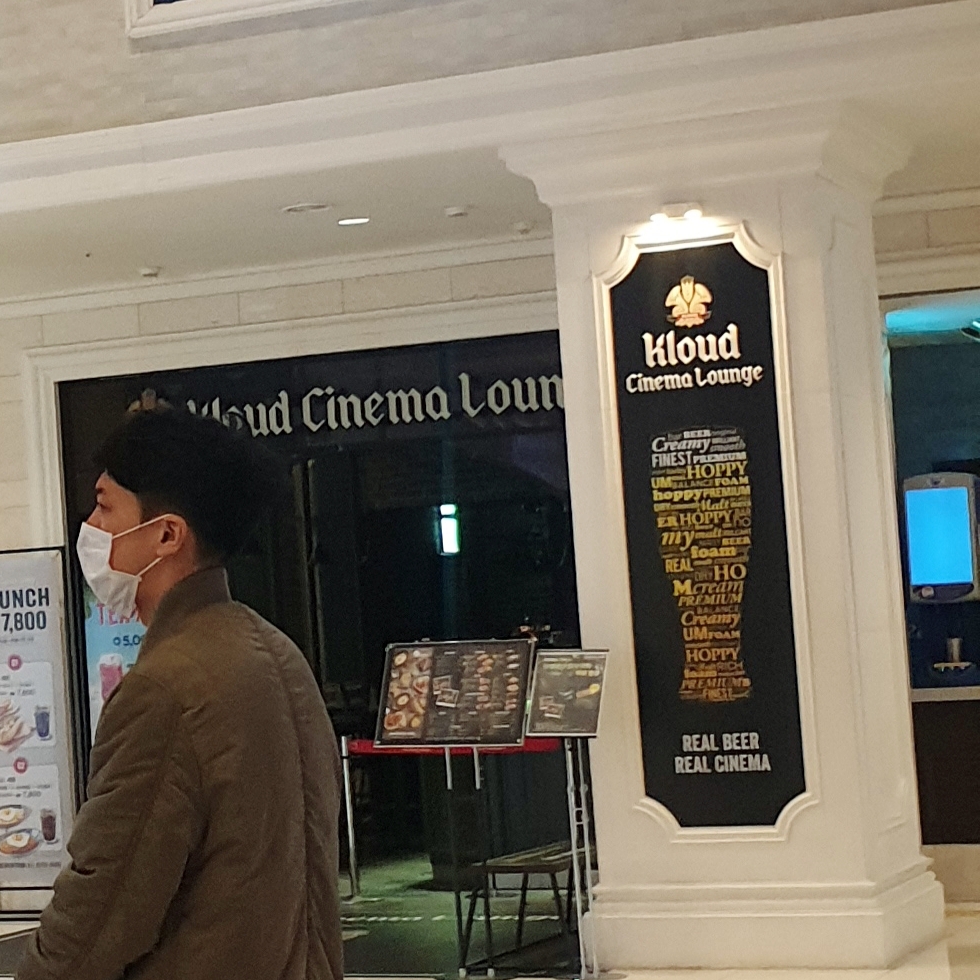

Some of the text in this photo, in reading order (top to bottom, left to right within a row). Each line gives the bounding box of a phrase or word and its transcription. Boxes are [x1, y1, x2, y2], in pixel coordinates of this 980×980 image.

[642, 323, 741, 368] Kloud
[626, 364, 763, 393] Cinema Lounge
[302, 385, 450, 432] Cinema
[459, 373, 565, 418] Loun
[652, 437, 711, 453] Creamy
[652, 451, 691, 467] FINEST
[687, 461, 748, 479] HOPPY
[715, 476, 749, 486] FOAM
[652, 486, 750, 502] hoppy PREMIUM
[680, 510, 733, 525] HOPPY
[661, 530, 695, 551] my
[690, 546, 736, 559] foam
[665, 559, 693, 573] REAL
[714, 564, 747, 580] HO
[693, 581, 744, 594] cream
[678, 594, 742, 606] PREMIUM
[681, 611, 740, 628] Creamy
[708, 631, 740, 639] FOAM
[686, 648, 740, 662] HOPPY
[682, 732, 760, 752] REAL BEER
[675, 754, 771, 773] REAL CINEMA
